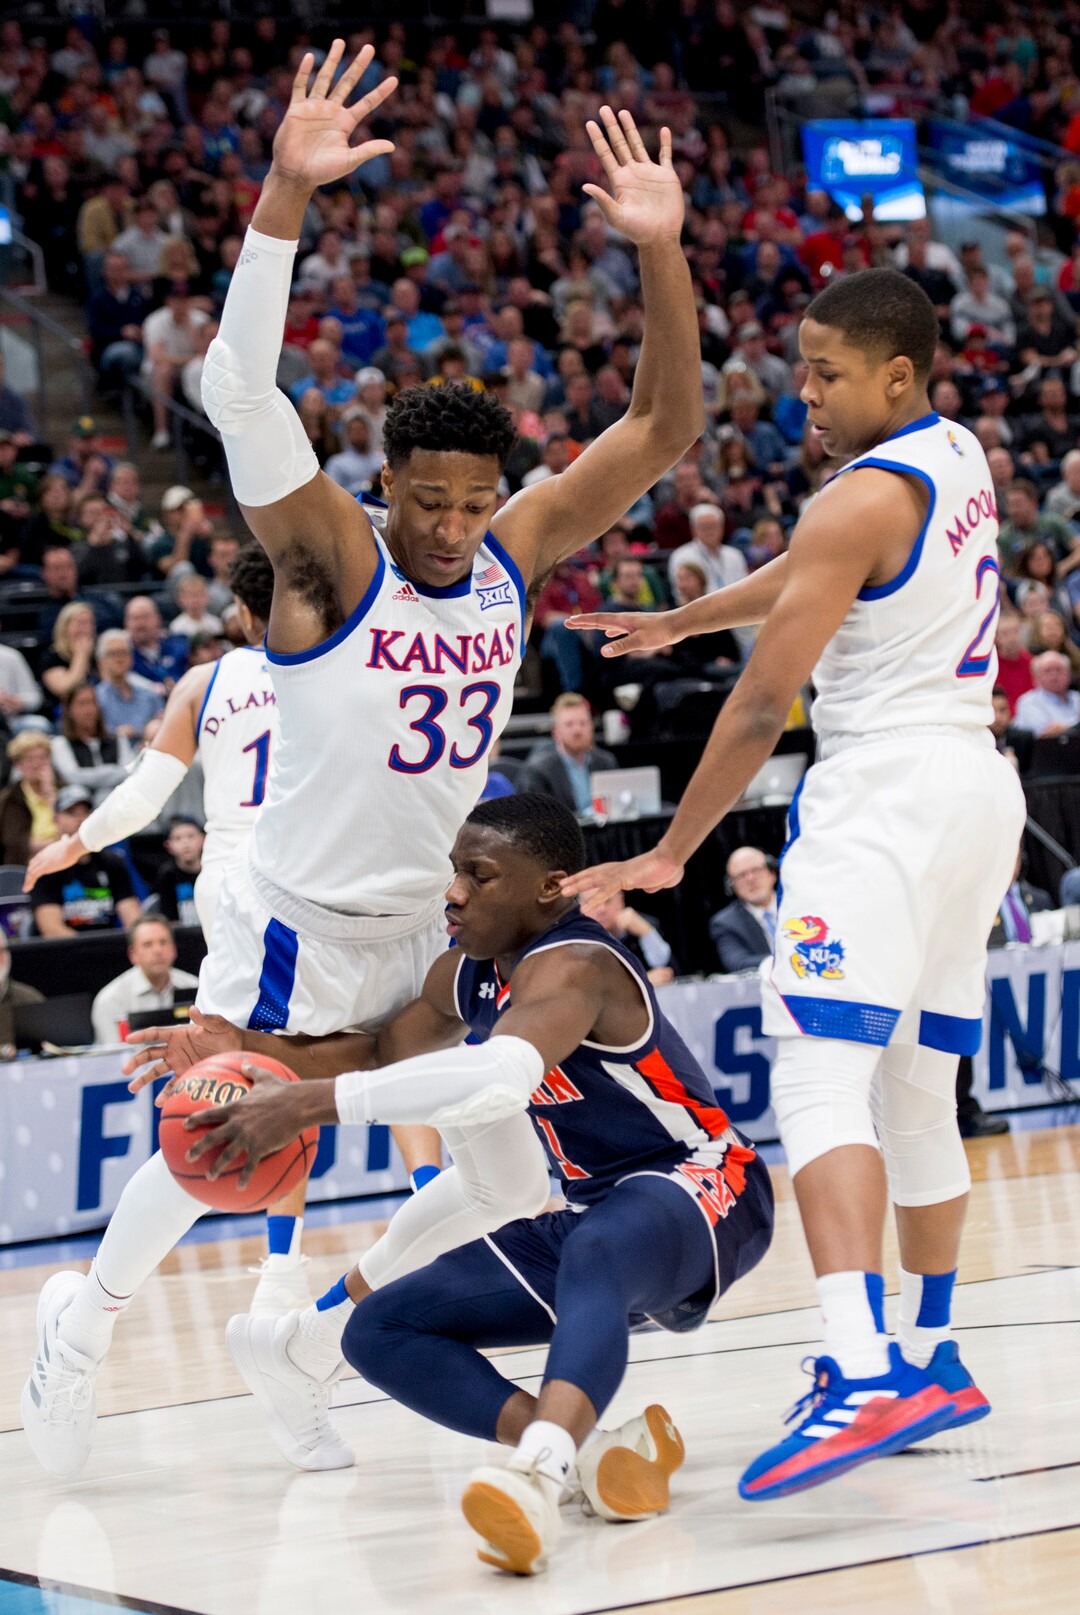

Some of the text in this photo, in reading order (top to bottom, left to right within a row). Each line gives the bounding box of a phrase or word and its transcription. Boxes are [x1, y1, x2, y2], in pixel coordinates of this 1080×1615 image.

[392, 593, 419, 602] adidas
[956, 555, 1000, 678] 2
[366, 623, 515, 675] KANSAS
[204, 716, 225, 737] D.
[388, 681, 501, 774] 33
[240, 730, 271, 806] 1
